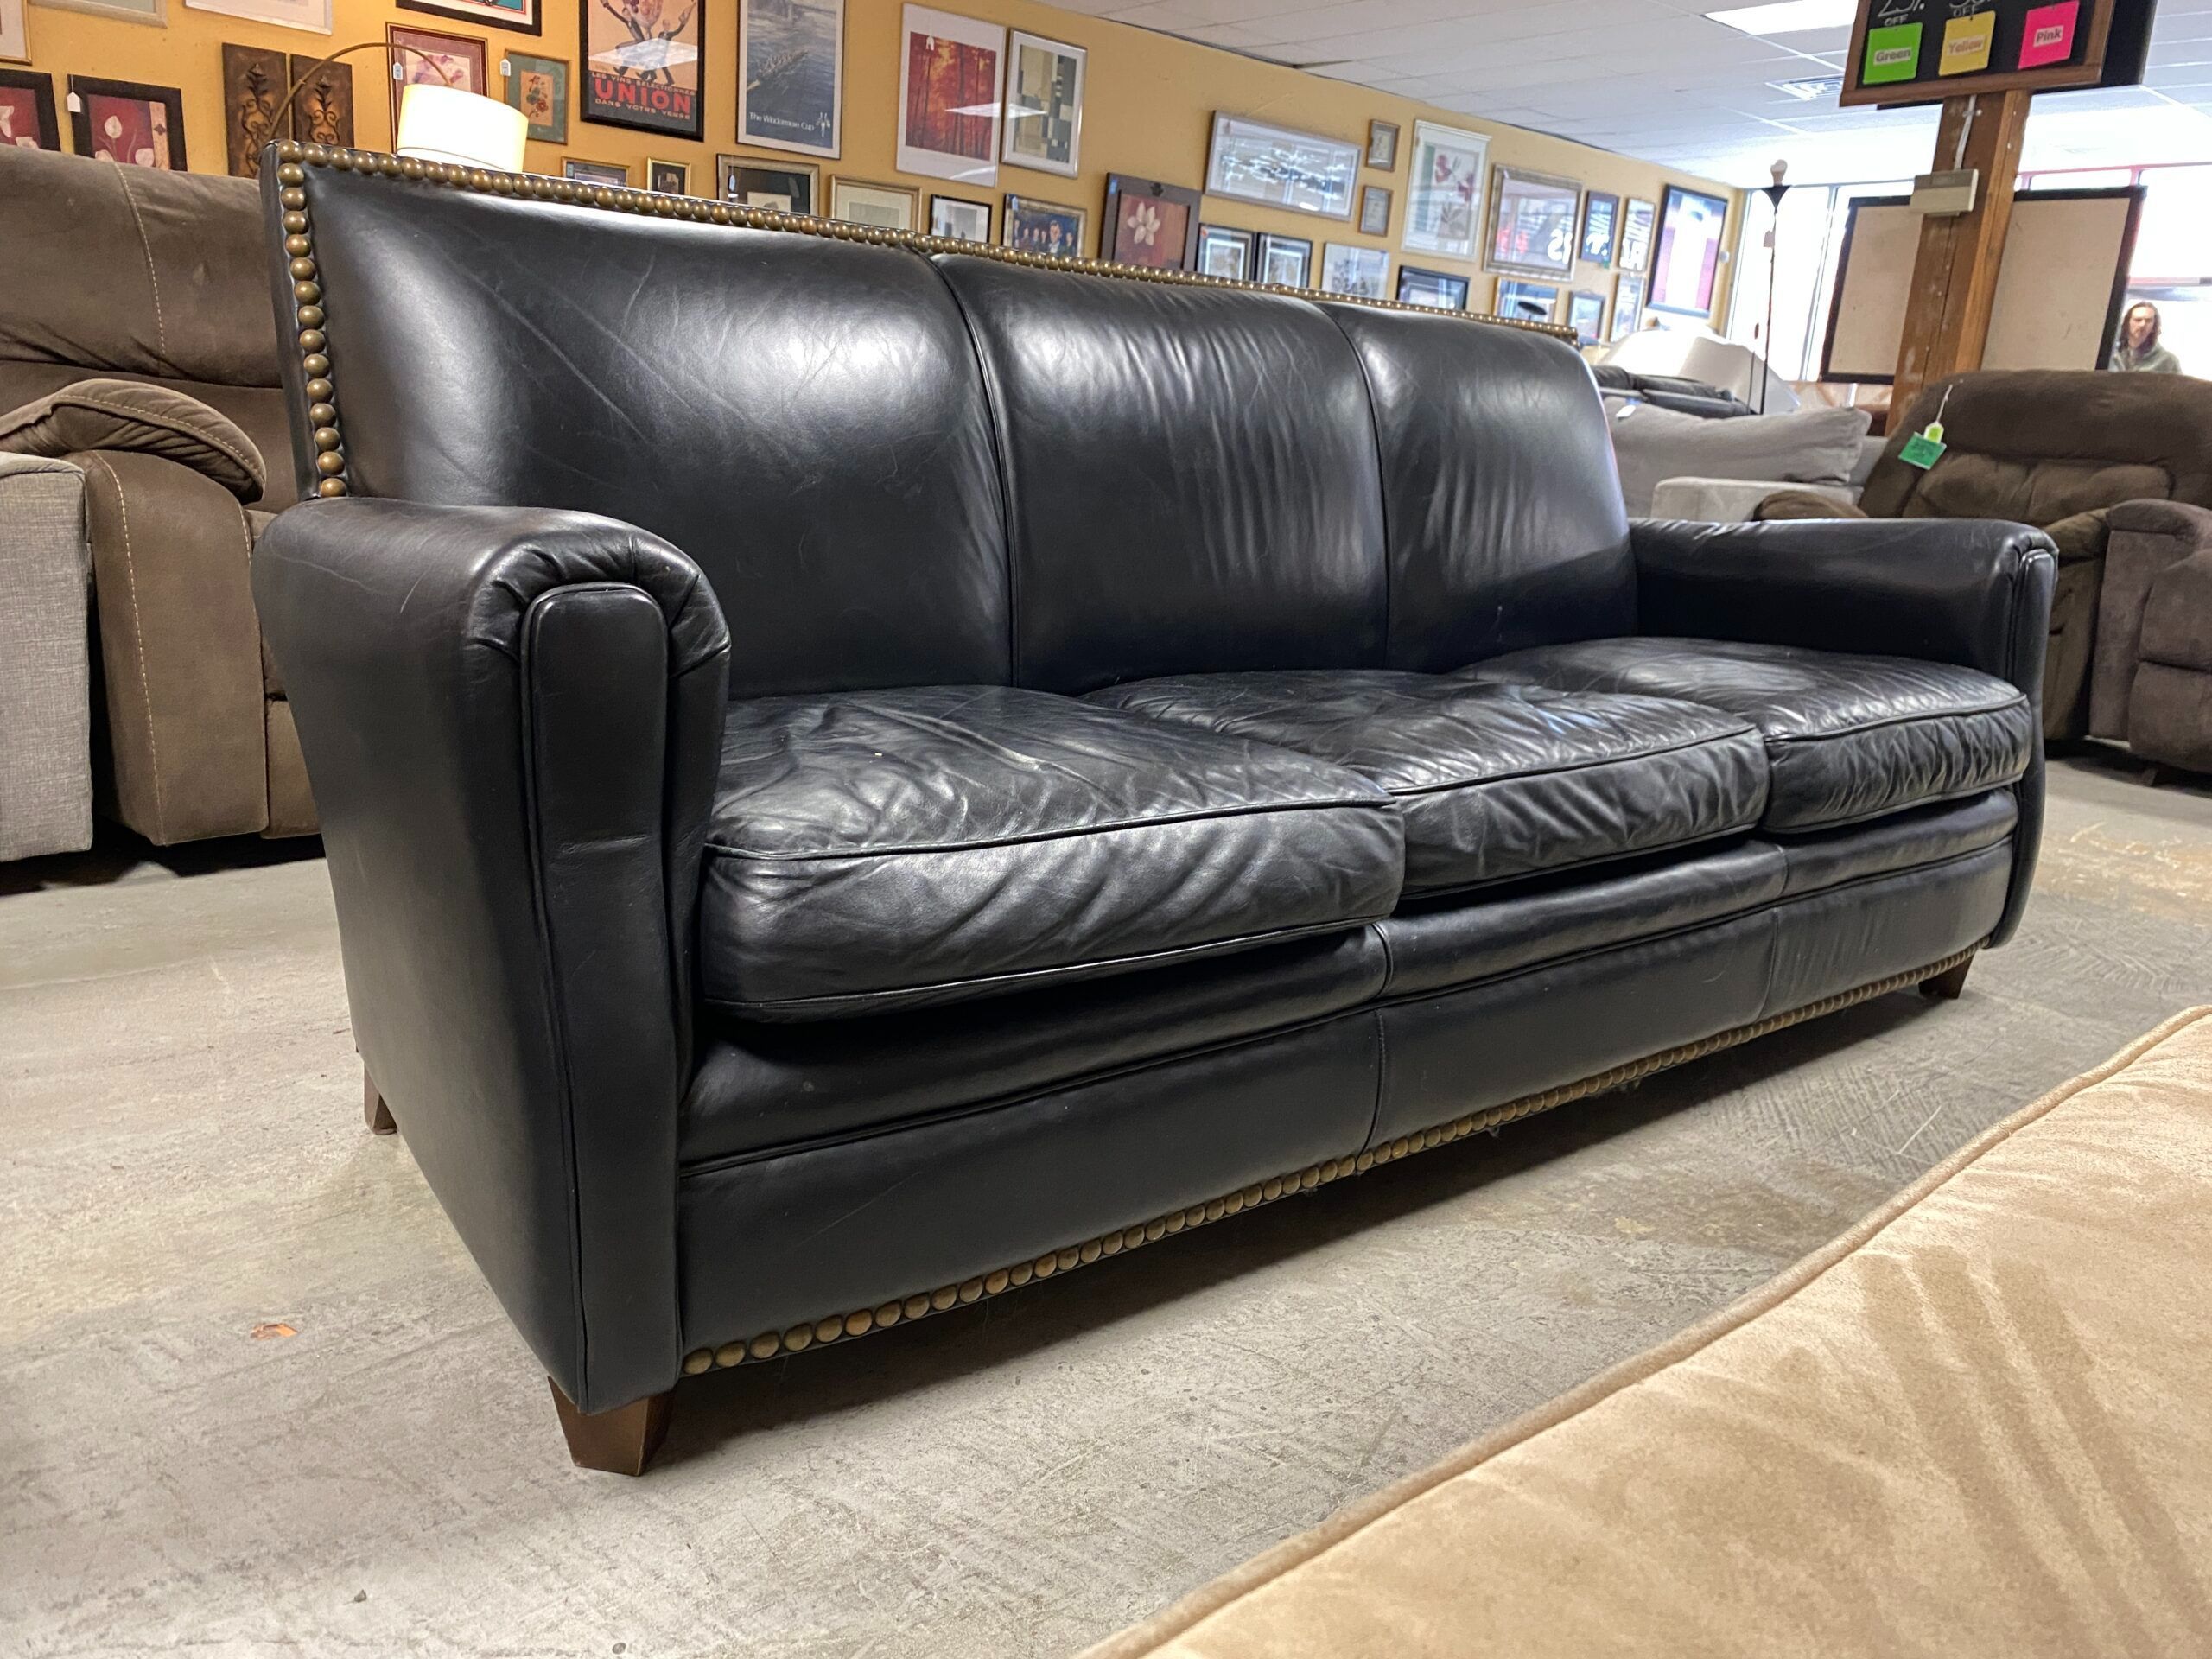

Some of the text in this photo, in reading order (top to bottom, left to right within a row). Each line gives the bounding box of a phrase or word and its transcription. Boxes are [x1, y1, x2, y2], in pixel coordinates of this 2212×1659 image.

[1953, 4, 1980, 17] OFF
[1884, 14, 1909, 27] OFF
[2036, 29, 2062, 43] Pink
[1948, 39, 1983, 54] Yellow
[1875, 48, 1911, 62] Green
[611, 75, 632, 85] VINS
[594, 78, 690, 115] UNION
[594, 98, 621, 108] DANS
[749, 111, 762, 122] The
[800, 121, 815, 131] Cup
